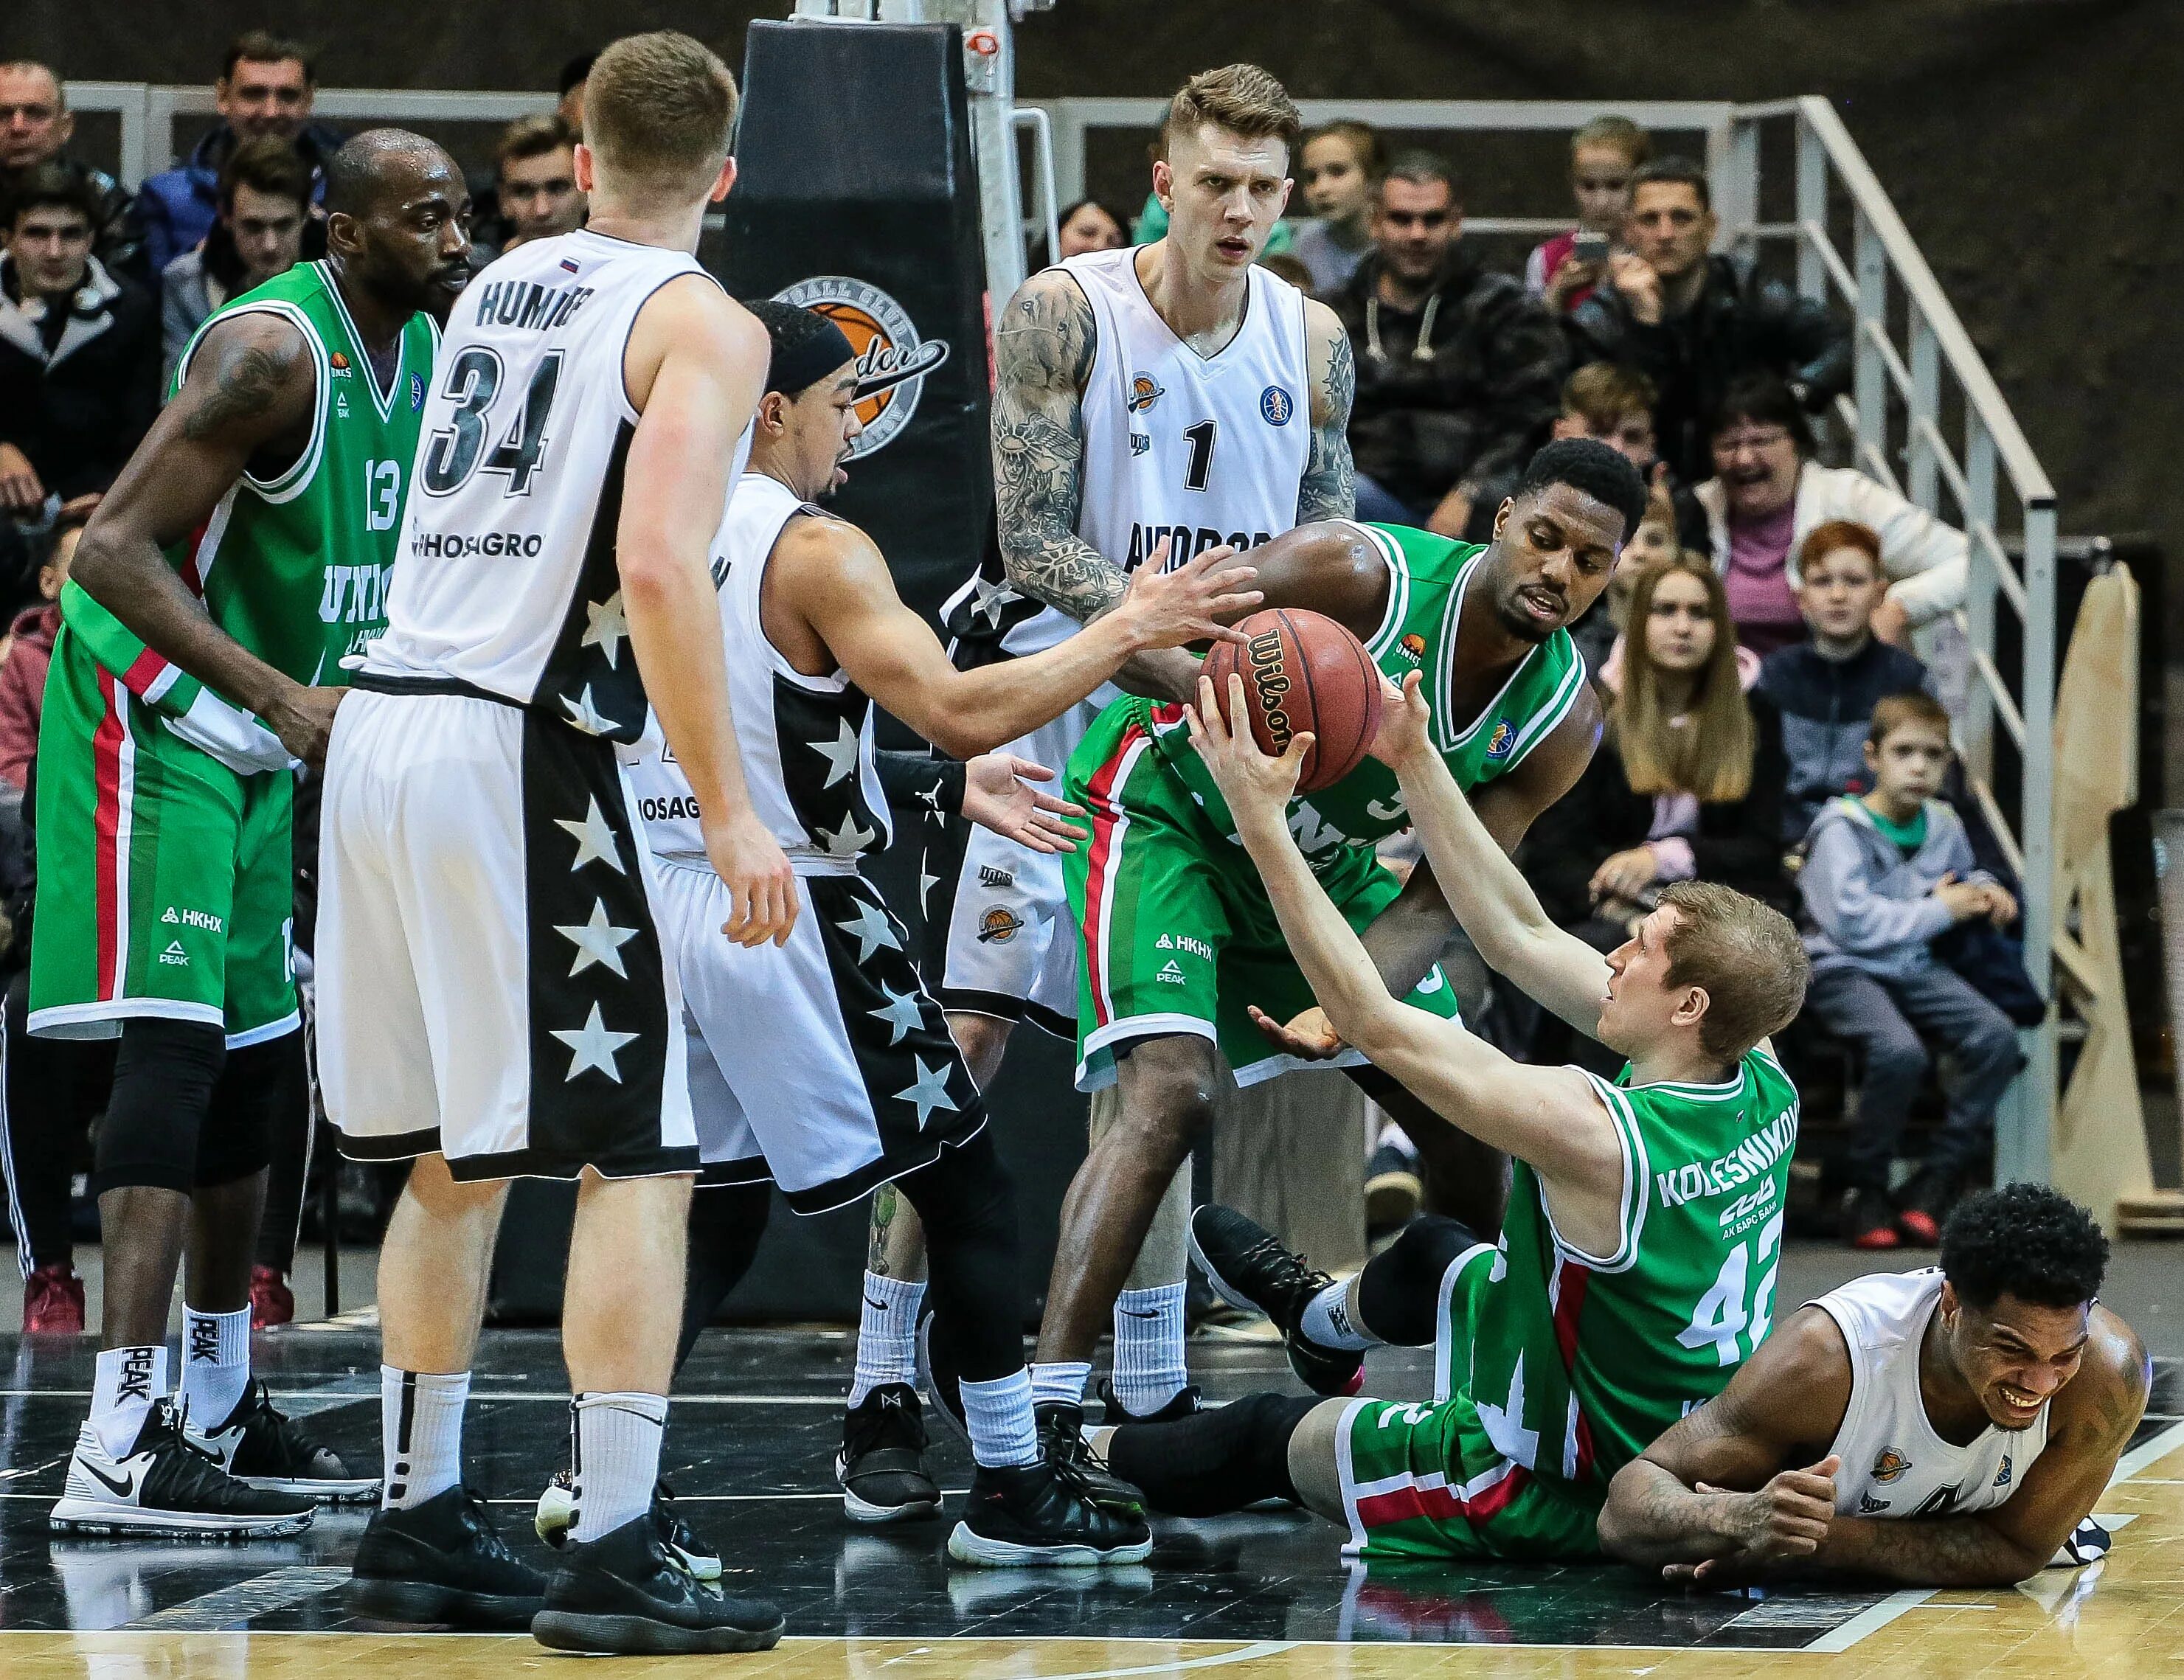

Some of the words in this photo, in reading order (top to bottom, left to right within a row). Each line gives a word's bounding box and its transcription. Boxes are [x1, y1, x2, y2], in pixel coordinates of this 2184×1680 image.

[420, 344, 565, 499] 34
[1182, 419, 1217, 493] 1
[365, 459, 401, 531] 13
[159, 954, 190, 968] PEAK
[1156, 973, 1187, 986] PEAK
[1657, 1098, 1800, 1209] KOLESNIKOV
[1675, 1207, 1783, 1367] 42
[114, 1346, 156, 1407] PEAK
[190, 1317, 220, 1366] PEAK
